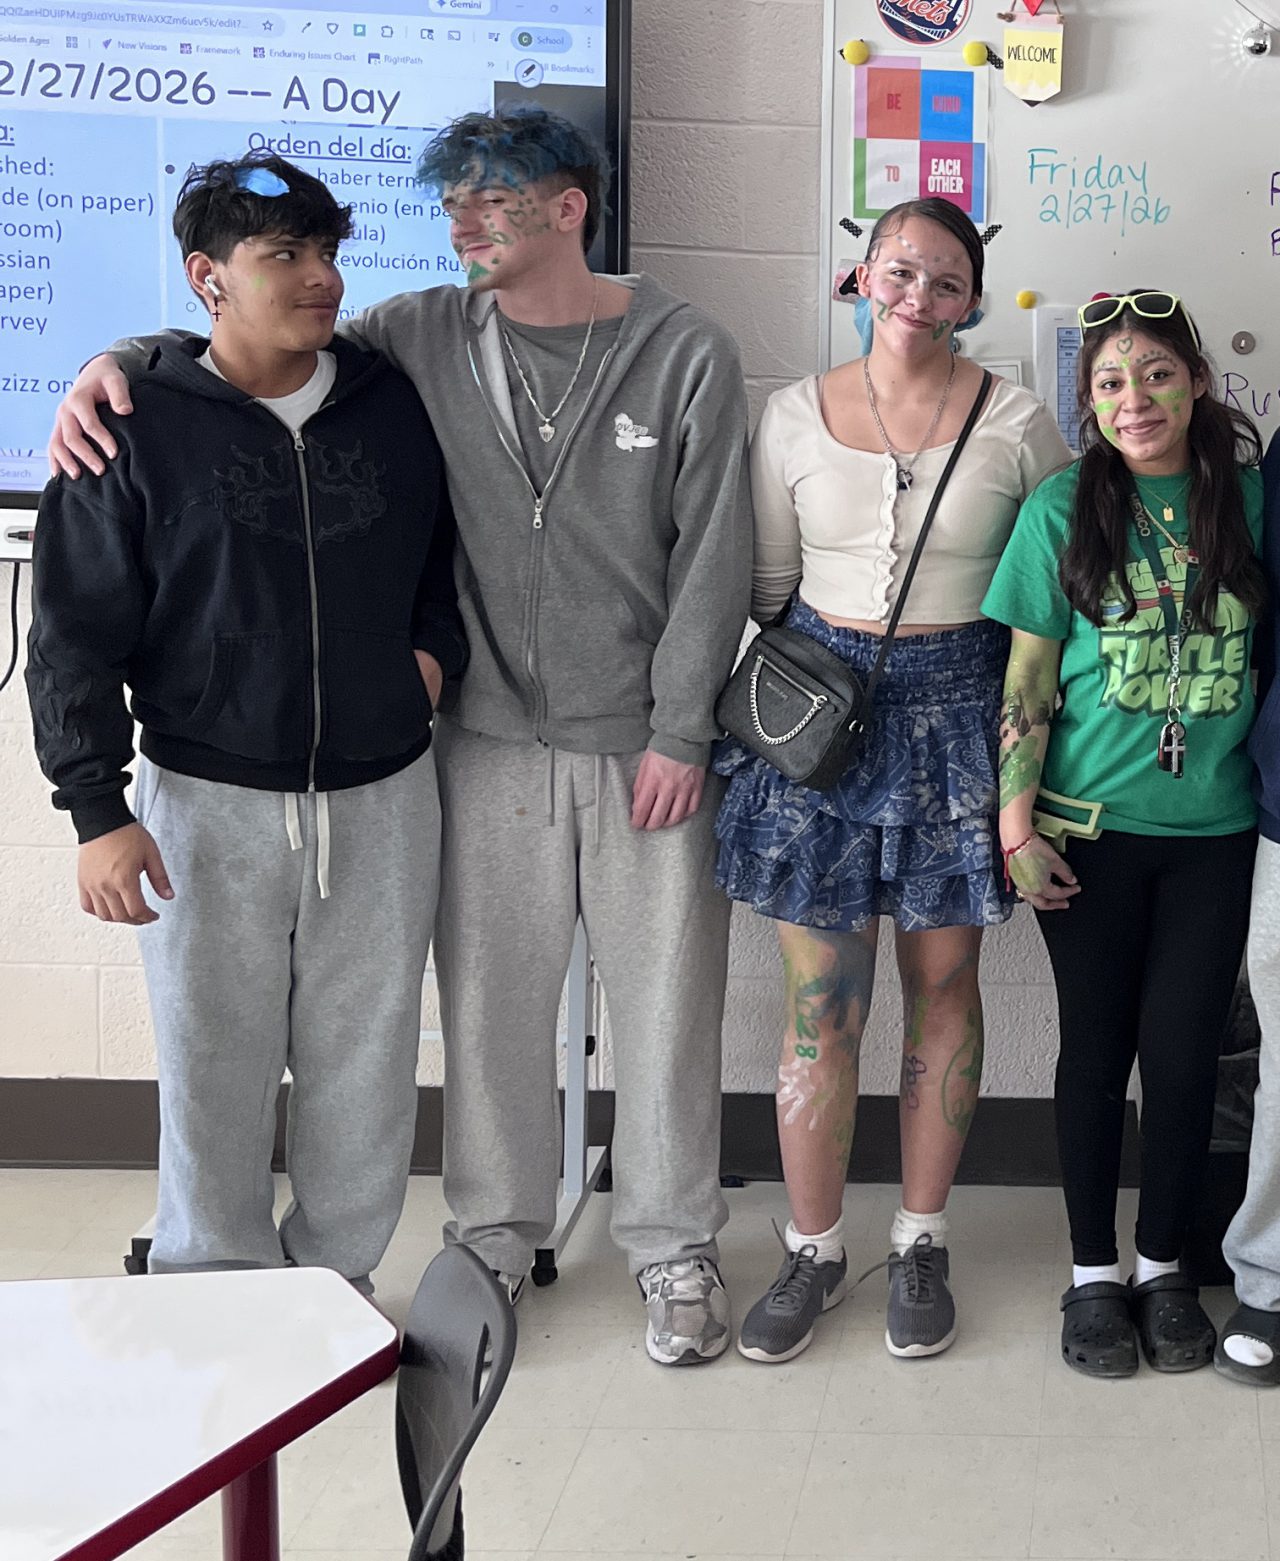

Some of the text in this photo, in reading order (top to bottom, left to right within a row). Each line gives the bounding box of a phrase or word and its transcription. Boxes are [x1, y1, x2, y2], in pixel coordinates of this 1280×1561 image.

[30, 36, 50, 45] Ages
[117, 40, 137, 50] New
[138, 41, 168, 52] Visions
[537, 36, 564, 46] School
[269, 48, 305, 62] Enduring
[307, 51, 332, 61] Issues
[333, 52, 356, 63] Chart
[384, 54, 423, 65] RightPath
[1007, 45, 1057, 64] WELCOME
[551, 64, 594, 74] Bookmarks
[0, 59, 217, 105] 2/27/2026
[283, 76, 310, 111] A
[323, 78, 400, 125] Day
[886, 93, 902, 110] BE
[249, 132, 412, 160] Orden del día:
[884, 165, 900, 182] TO
[931, 158, 962, 176] EACH
[1028, 148, 1148, 194] Friday
[317, 169, 378, 187] haber
[927, 175, 964, 193] OTHER
[38, 187, 73, 211] (on
[82, 192, 154, 217] paper)
[339, 199, 388, 214] enio
[394, 199, 423, 218] (en
[1039, 189, 1170, 237] 2/27/26
[352, 225, 386, 245] ula)
[335, 252, 430, 270] evolución
[1100, 633, 1246, 675] TURTLE
[1101, 665, 1241, 714] POWER
